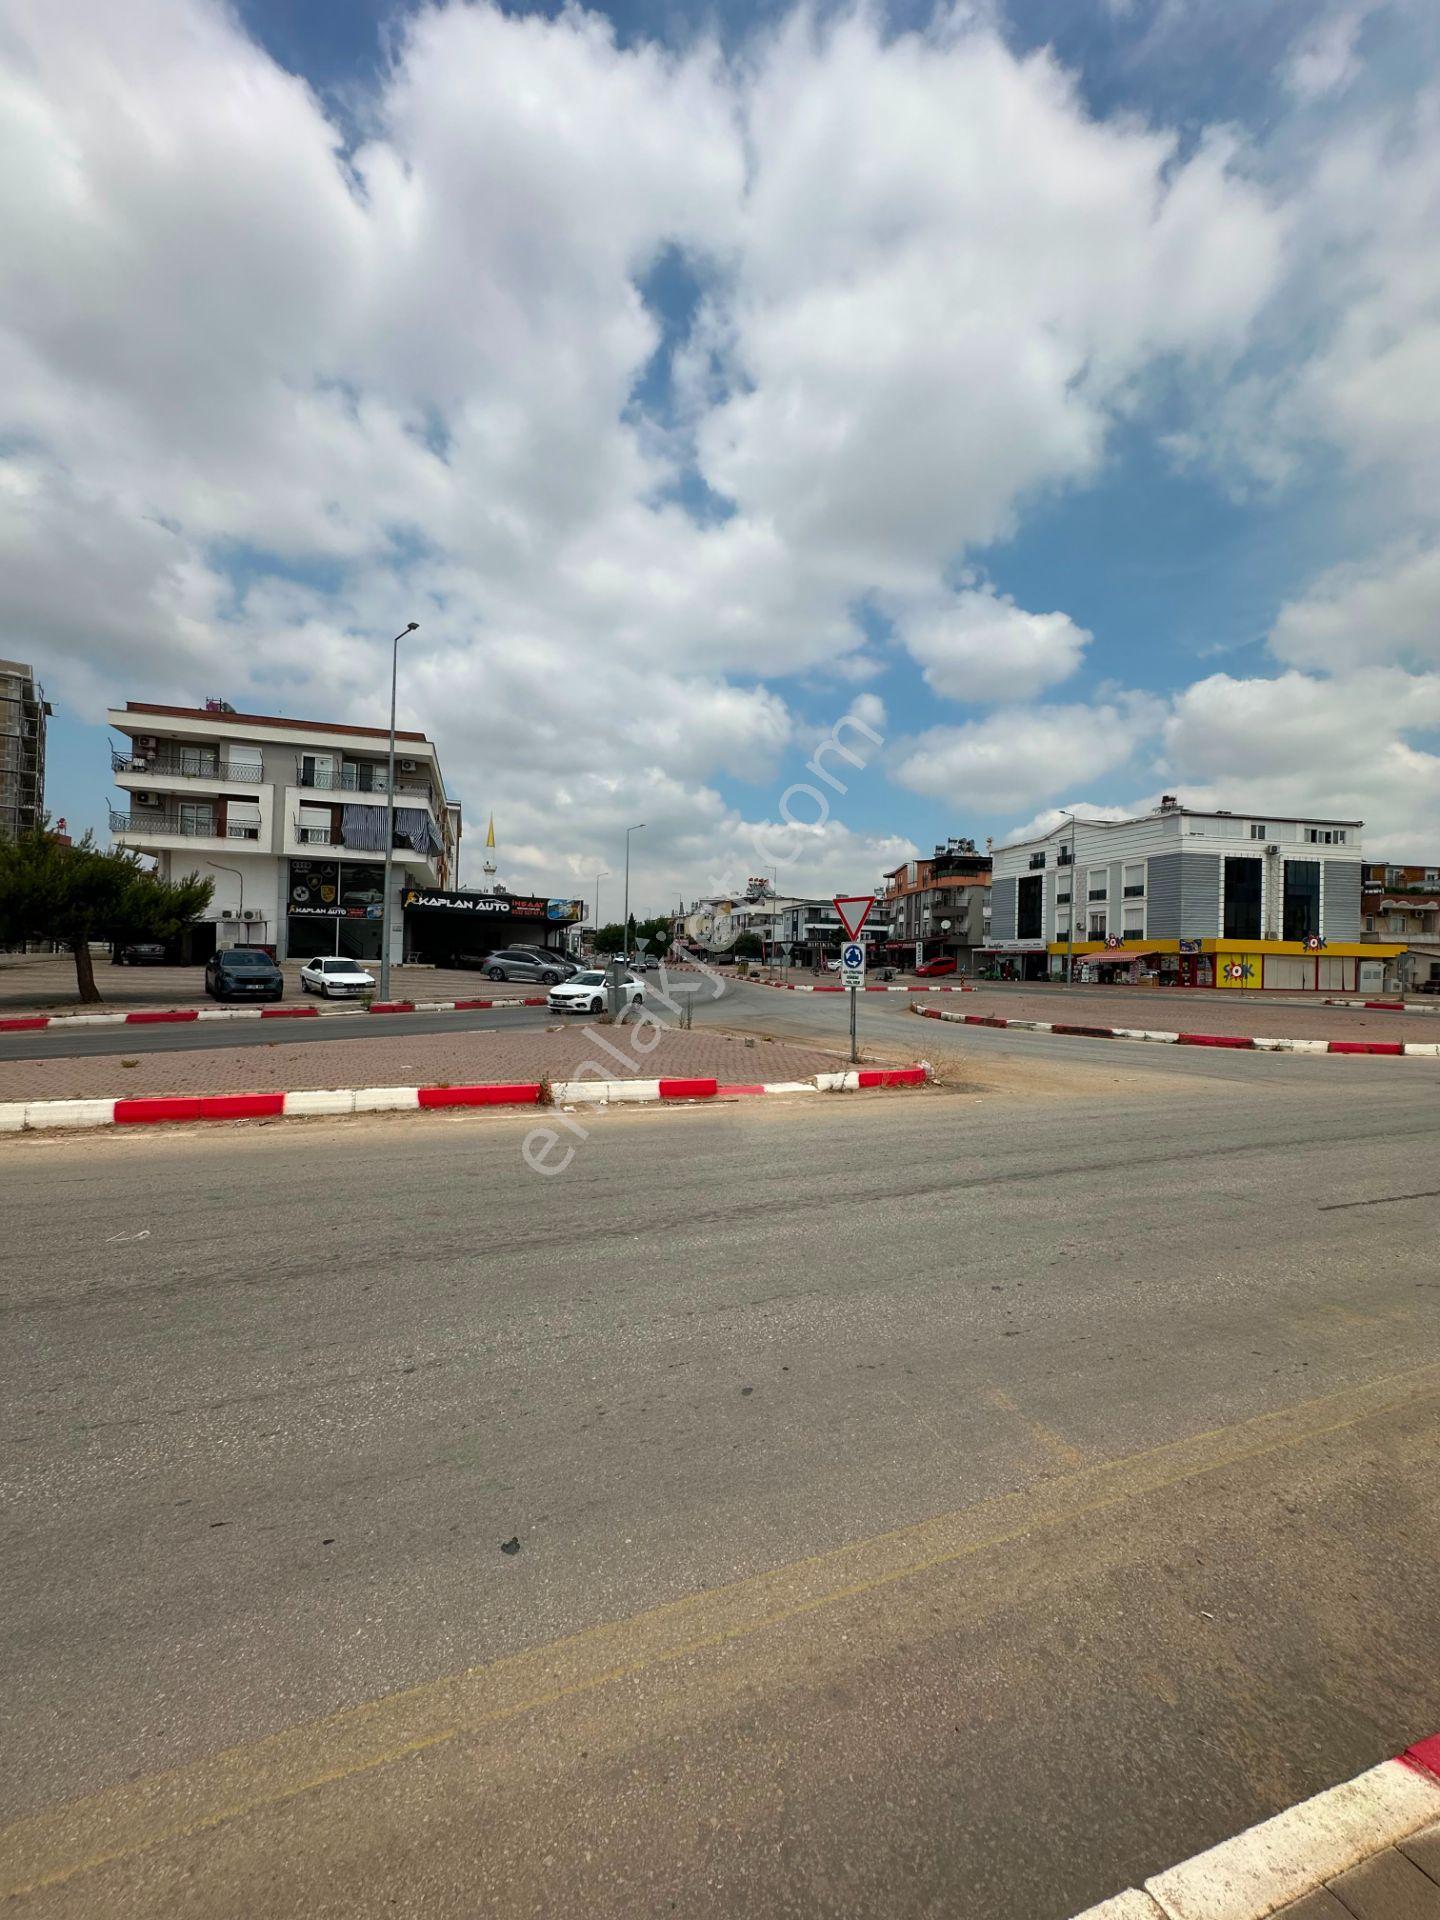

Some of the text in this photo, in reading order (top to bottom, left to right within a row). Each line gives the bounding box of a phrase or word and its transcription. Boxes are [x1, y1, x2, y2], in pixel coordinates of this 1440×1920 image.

[418, 897, 474, 909] KAPLAN
[476, 902, 510, 911] AUTO
[295, 906, 326, 914] KAPLAN
